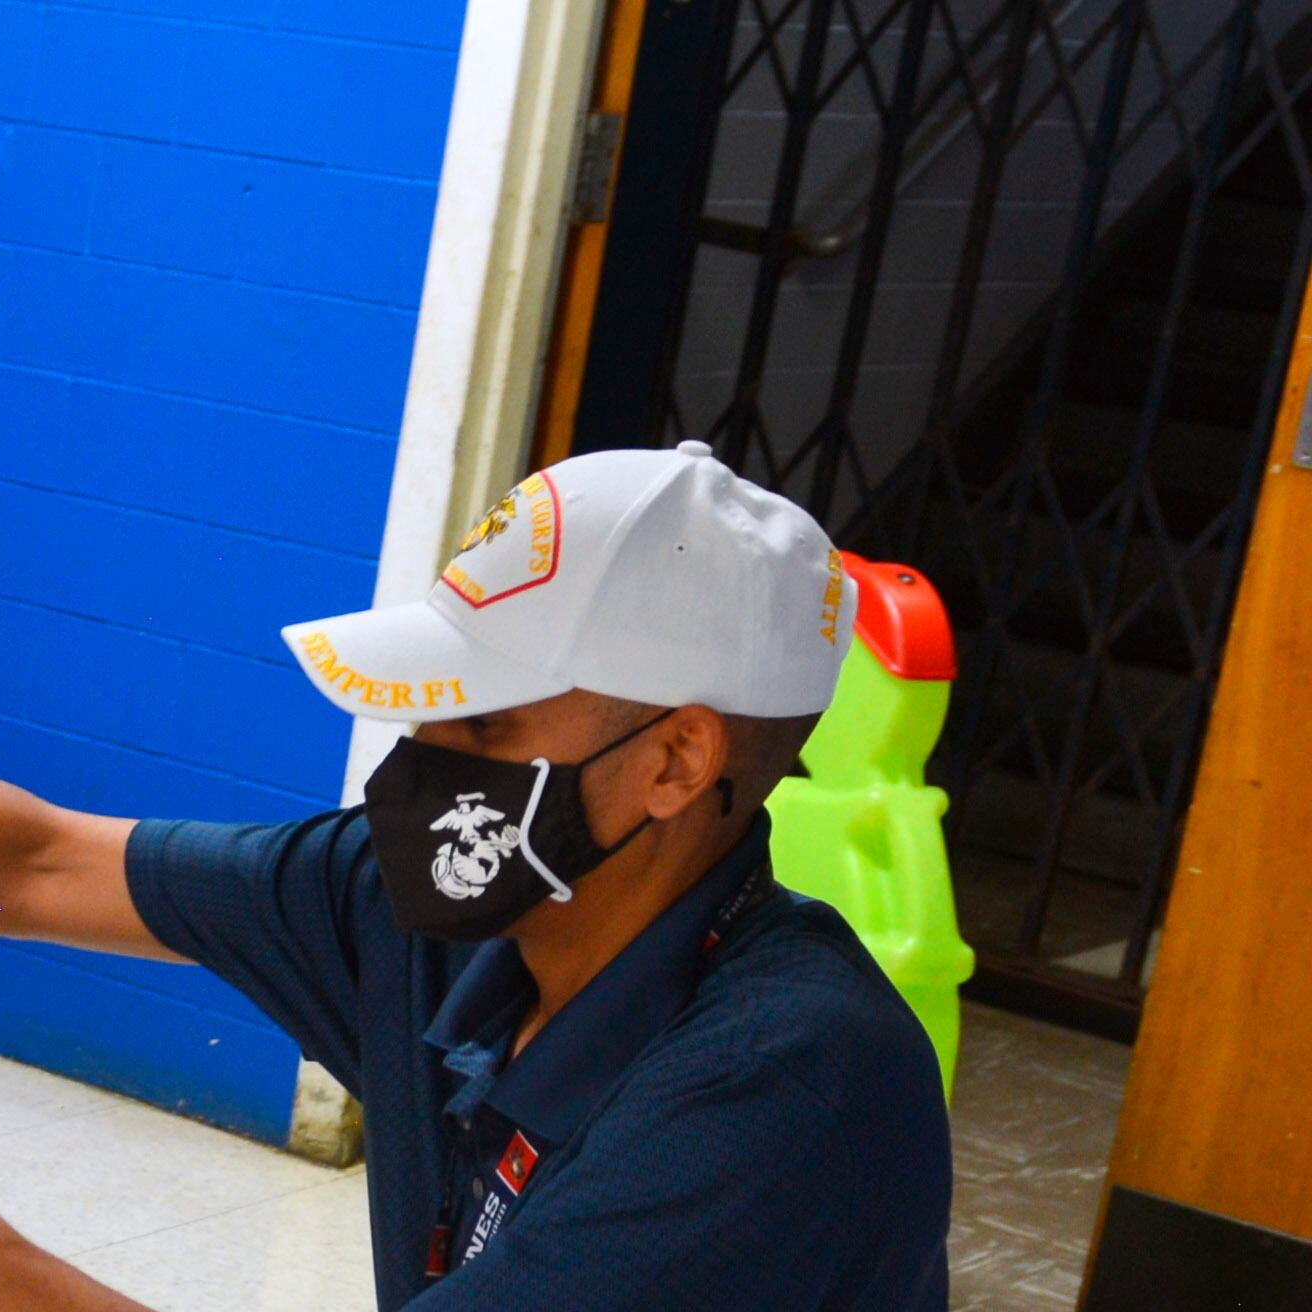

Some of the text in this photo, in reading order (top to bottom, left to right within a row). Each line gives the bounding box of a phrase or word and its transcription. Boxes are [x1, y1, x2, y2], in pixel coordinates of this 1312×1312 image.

[529, 498, 553, 574] CORPS
[299, 630, 468, 709] SEMPER FI
[461, 1191, 500, 1265] NES
